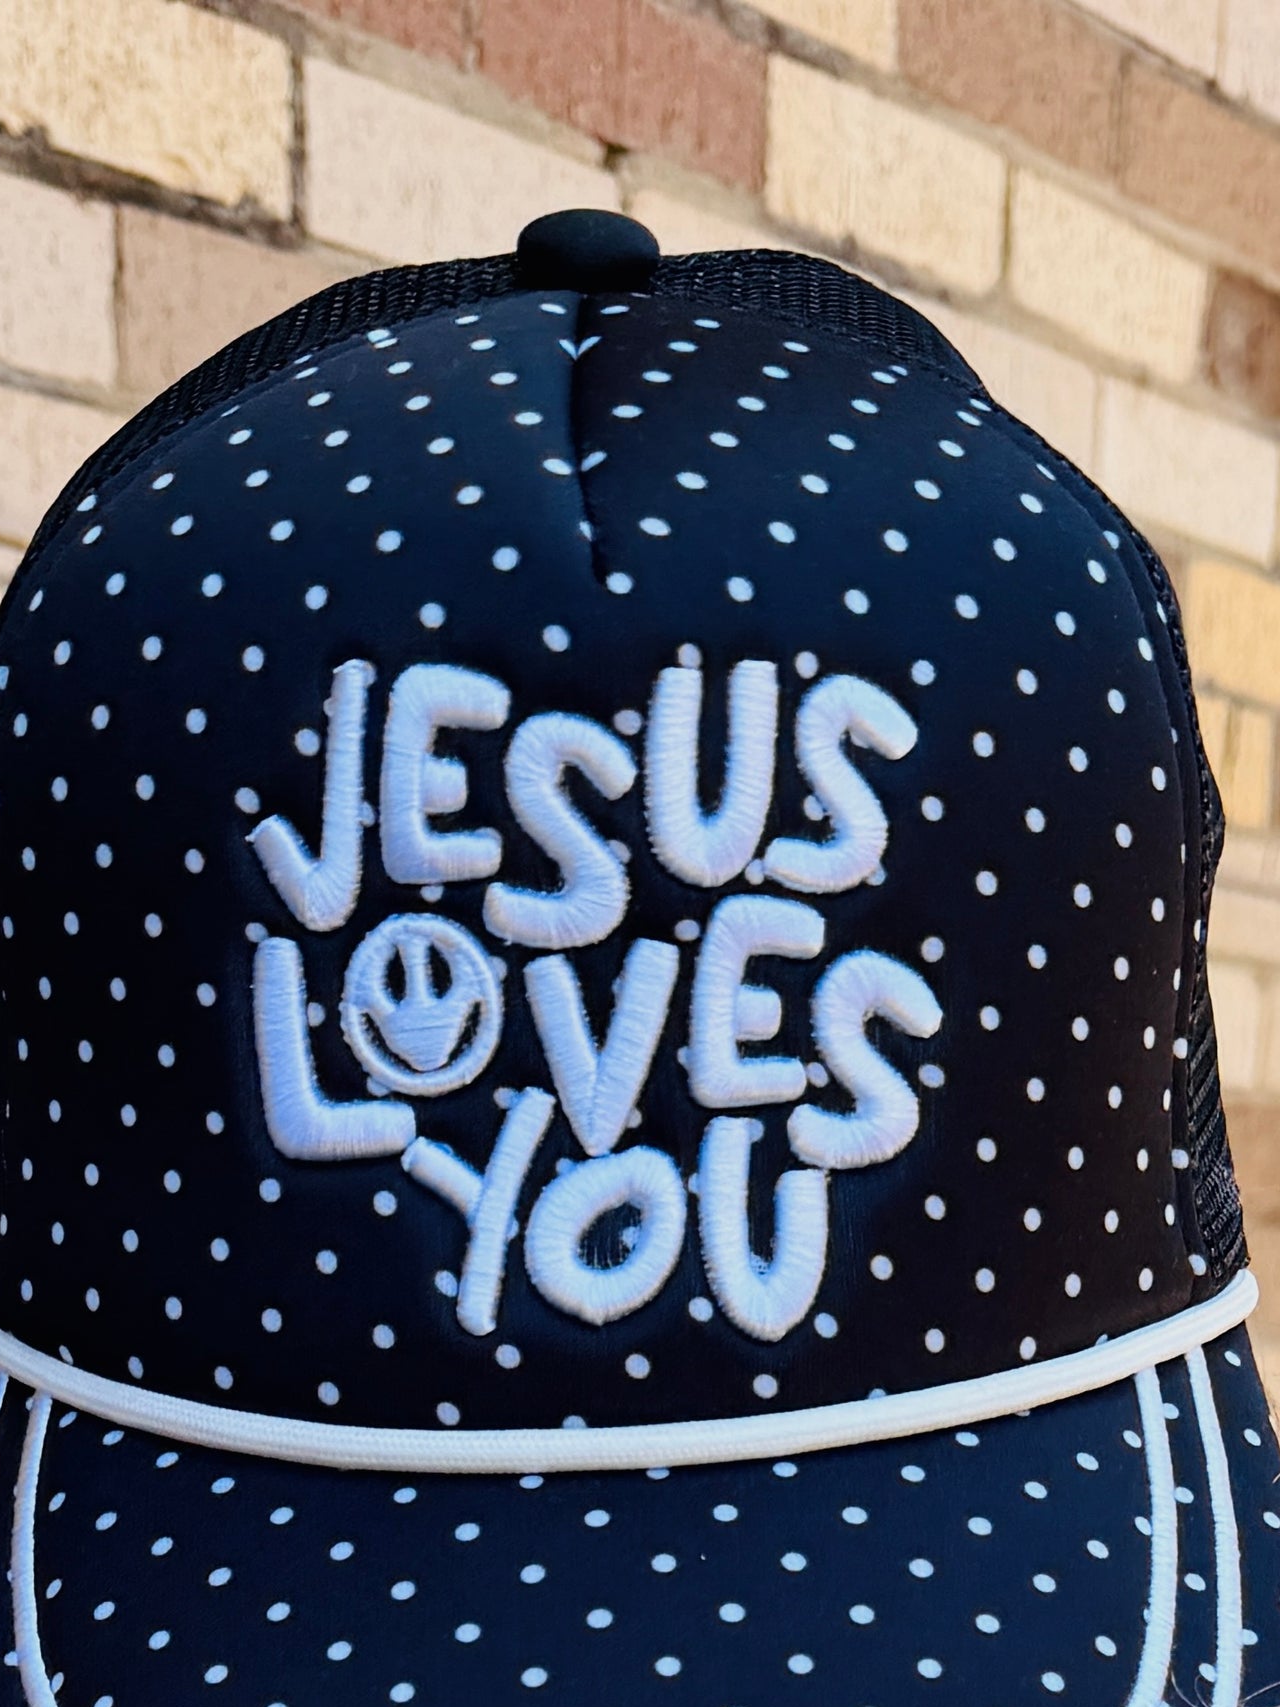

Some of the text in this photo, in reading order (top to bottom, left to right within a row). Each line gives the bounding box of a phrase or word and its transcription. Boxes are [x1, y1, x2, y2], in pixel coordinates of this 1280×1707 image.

[245, 658, 919, 949] JESUS
[252, 894, 944, 1171] LOVES
[400, 1087, 831, 1343] YOU
